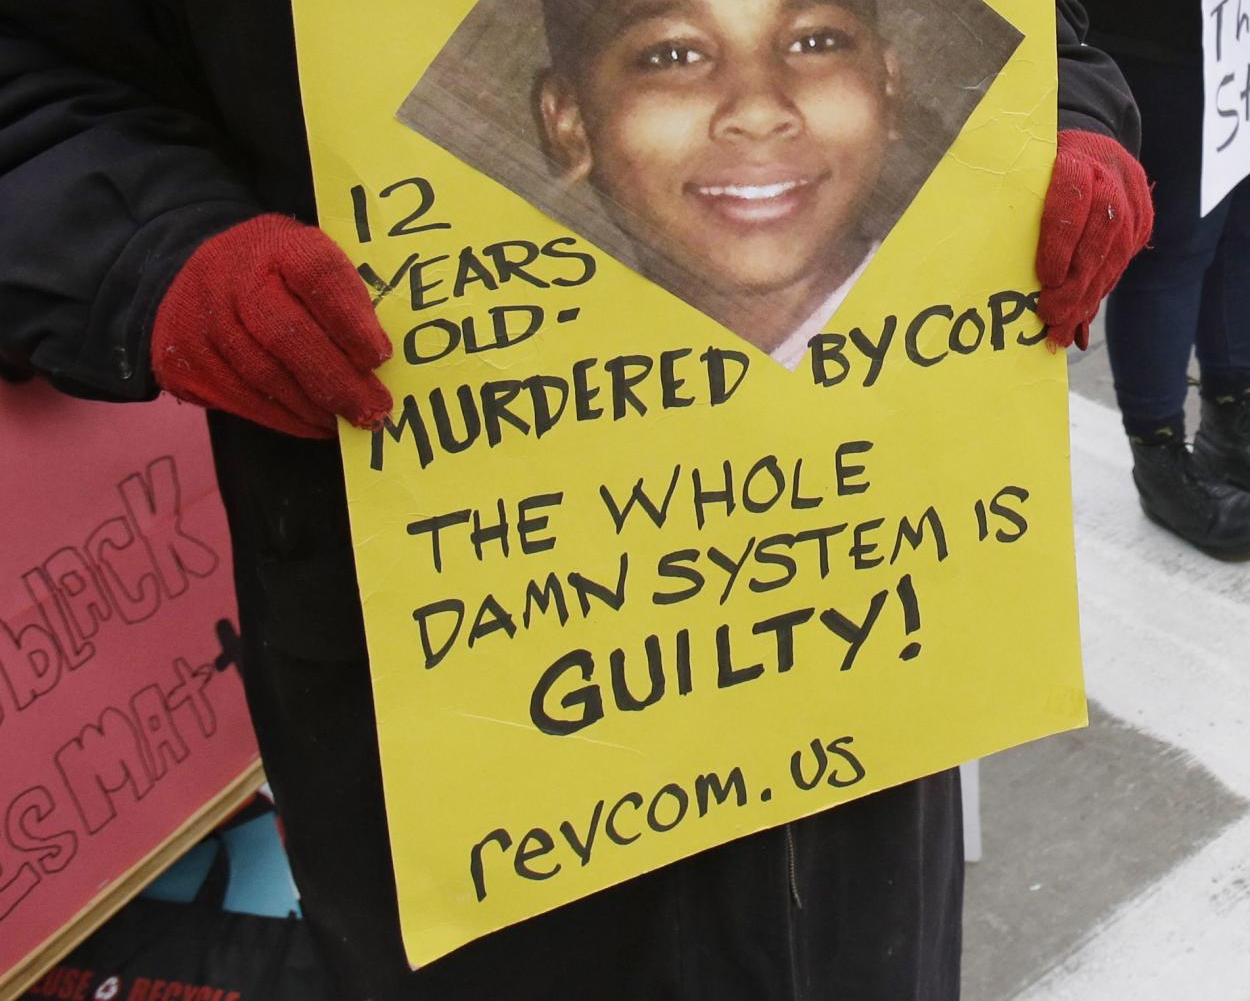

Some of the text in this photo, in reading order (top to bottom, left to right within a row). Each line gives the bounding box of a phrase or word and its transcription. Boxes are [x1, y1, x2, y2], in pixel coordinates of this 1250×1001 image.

[350, 176, 451, 244] 12
[357, 236, 598, 312] YEARS
[370, 345, 751, 472] MURDERED
[406, 440, 875, 573] THE WHOLE
[413, 485, 1030, 670] DAMN SYSTEM IS
[529, 574, 923, 737] GUILTY!
